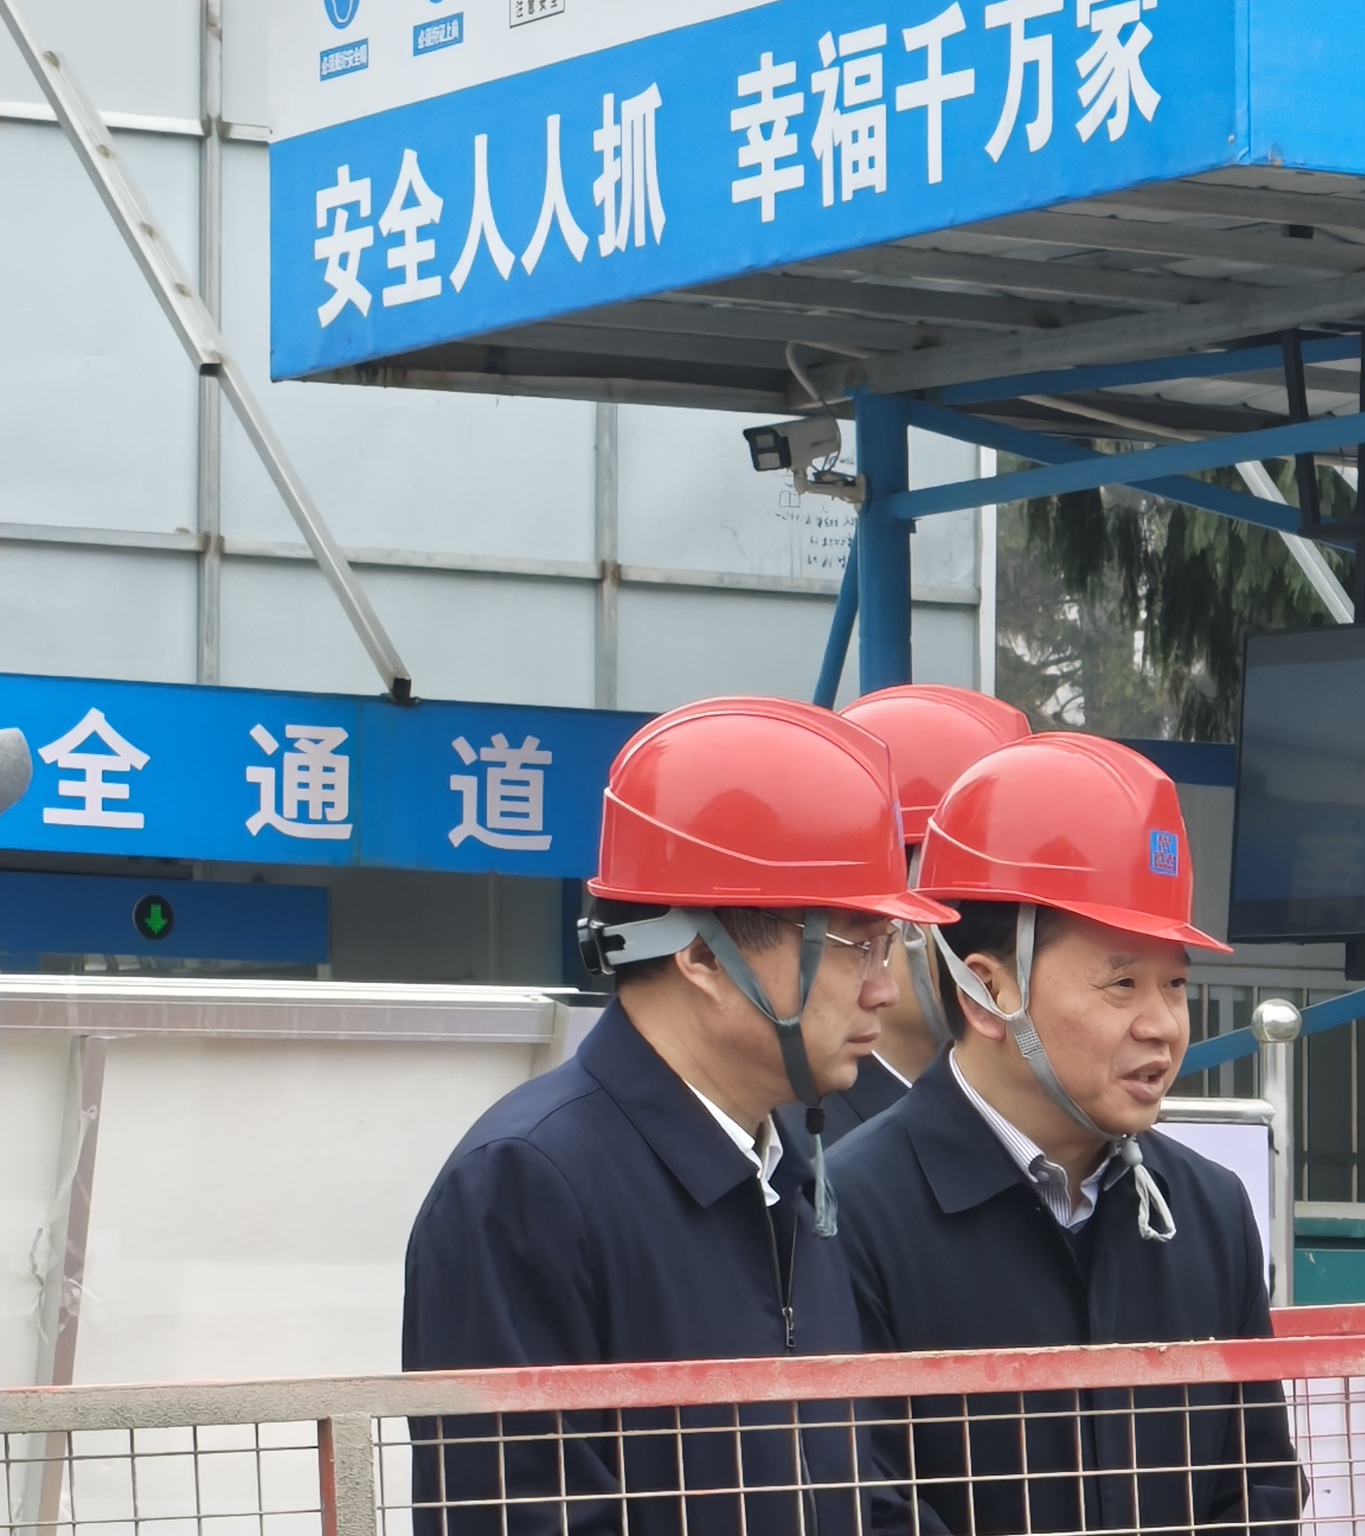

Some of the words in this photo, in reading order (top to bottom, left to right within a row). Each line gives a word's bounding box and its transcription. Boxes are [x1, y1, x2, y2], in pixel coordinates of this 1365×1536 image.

[314, 81, 666, 328] 安全人人抓
[729, 0, 1162, 222] 幸福千万家
[38, 707, 553, 851] 全通道
